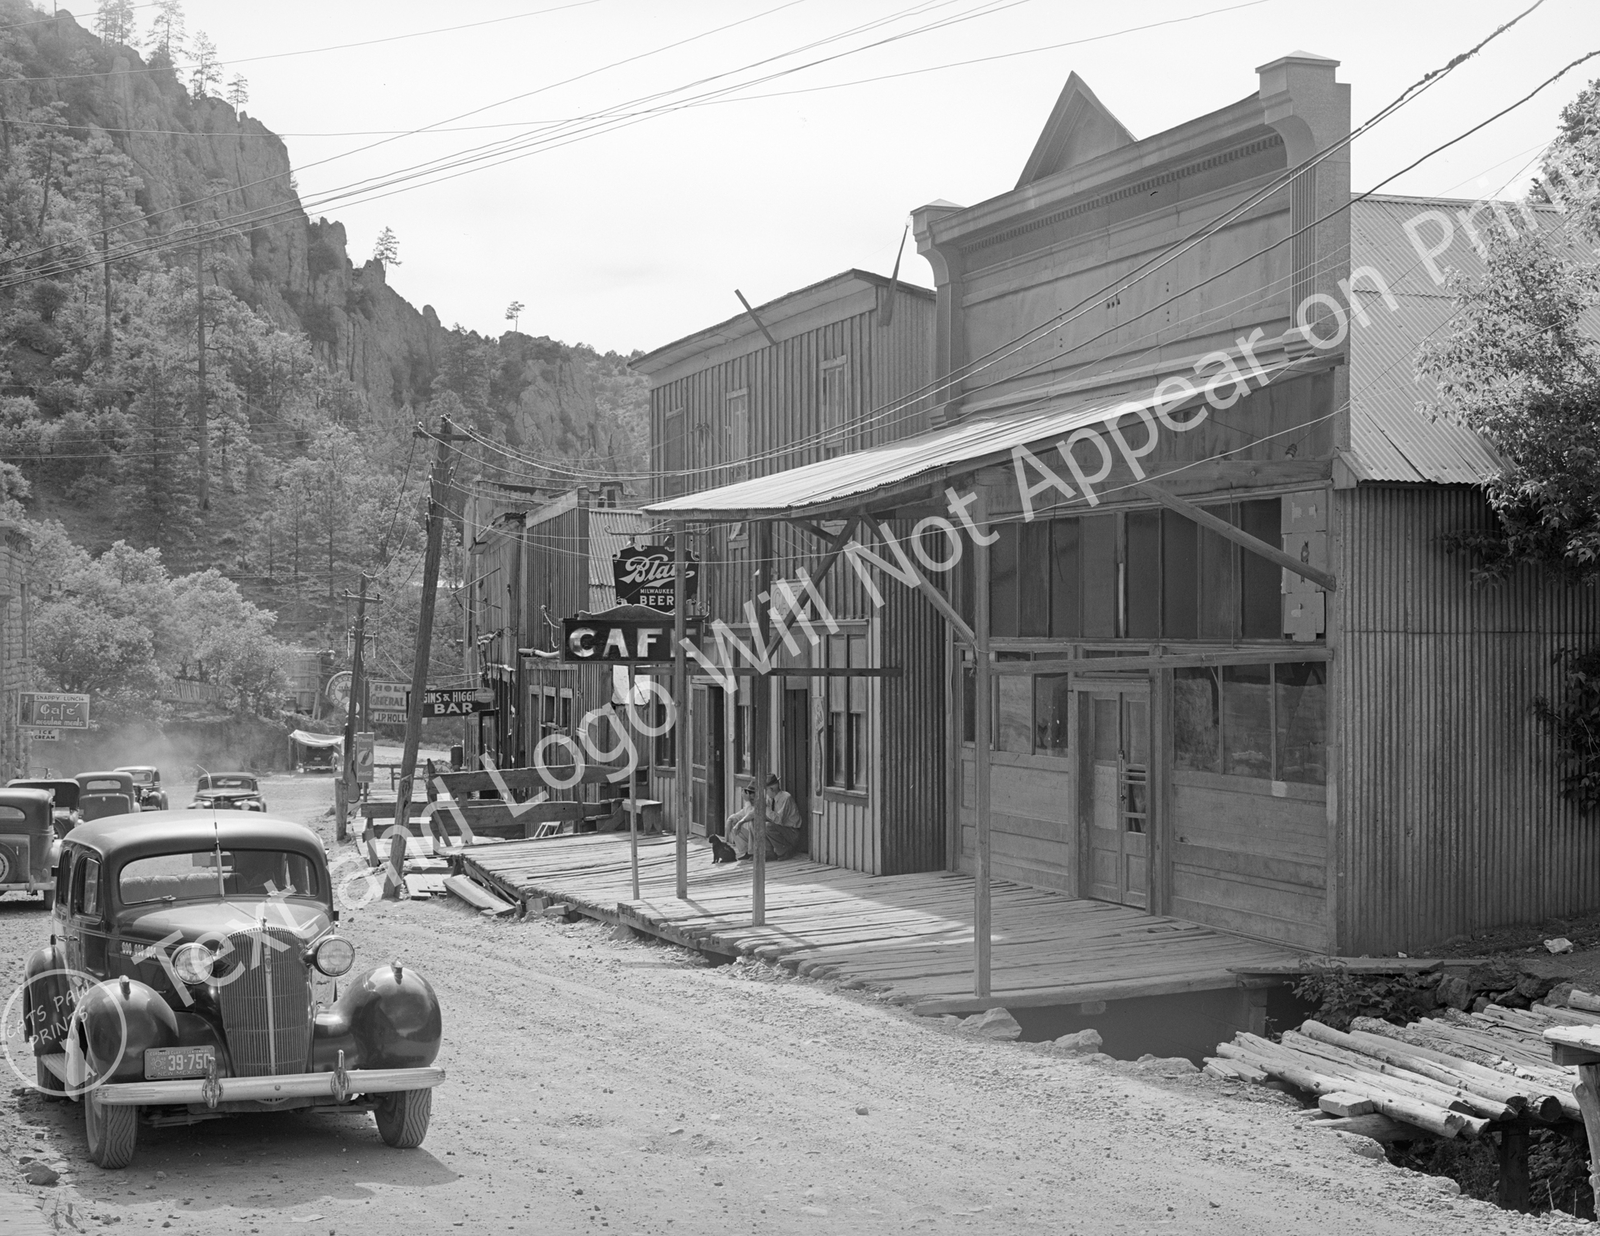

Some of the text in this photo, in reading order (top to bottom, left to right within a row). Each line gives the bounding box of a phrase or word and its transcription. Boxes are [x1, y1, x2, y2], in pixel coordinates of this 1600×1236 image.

[640, 595, 675, 606] BEER
[423, 692, 442, 704] GINS
[452, 691, 476, 702] HIGGI
[40, 703, 80, 720] Café
[434, 702, 473, 714] BAR
